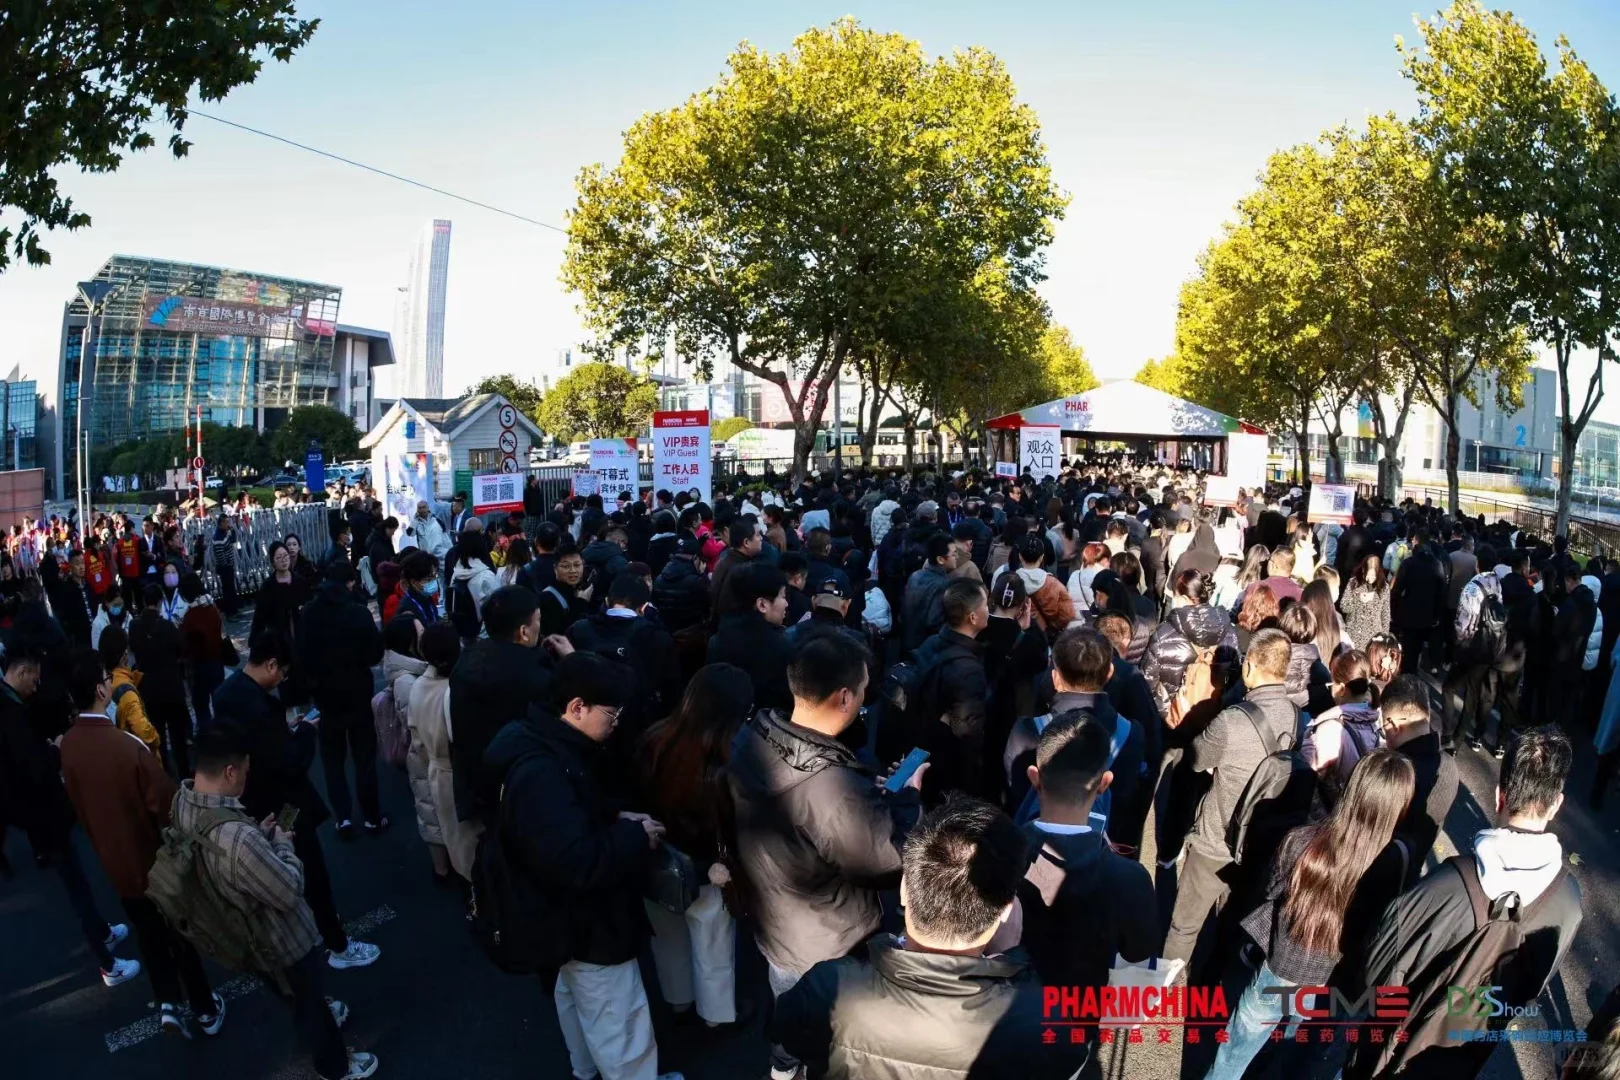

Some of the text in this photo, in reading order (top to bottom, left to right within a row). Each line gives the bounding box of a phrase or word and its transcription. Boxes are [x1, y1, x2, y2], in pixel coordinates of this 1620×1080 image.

[505, 411, 511, 423] 5
[1516, 425, 1527, 446] 2
[664, 449, 698, 457] VIP Guest
[1027, 440, 1054, 454] 观众
[1029, 456, 1053, 468] 入口
[663, 464, 699, 475] 工作人员
[672, 477, 689, 485] Staff
